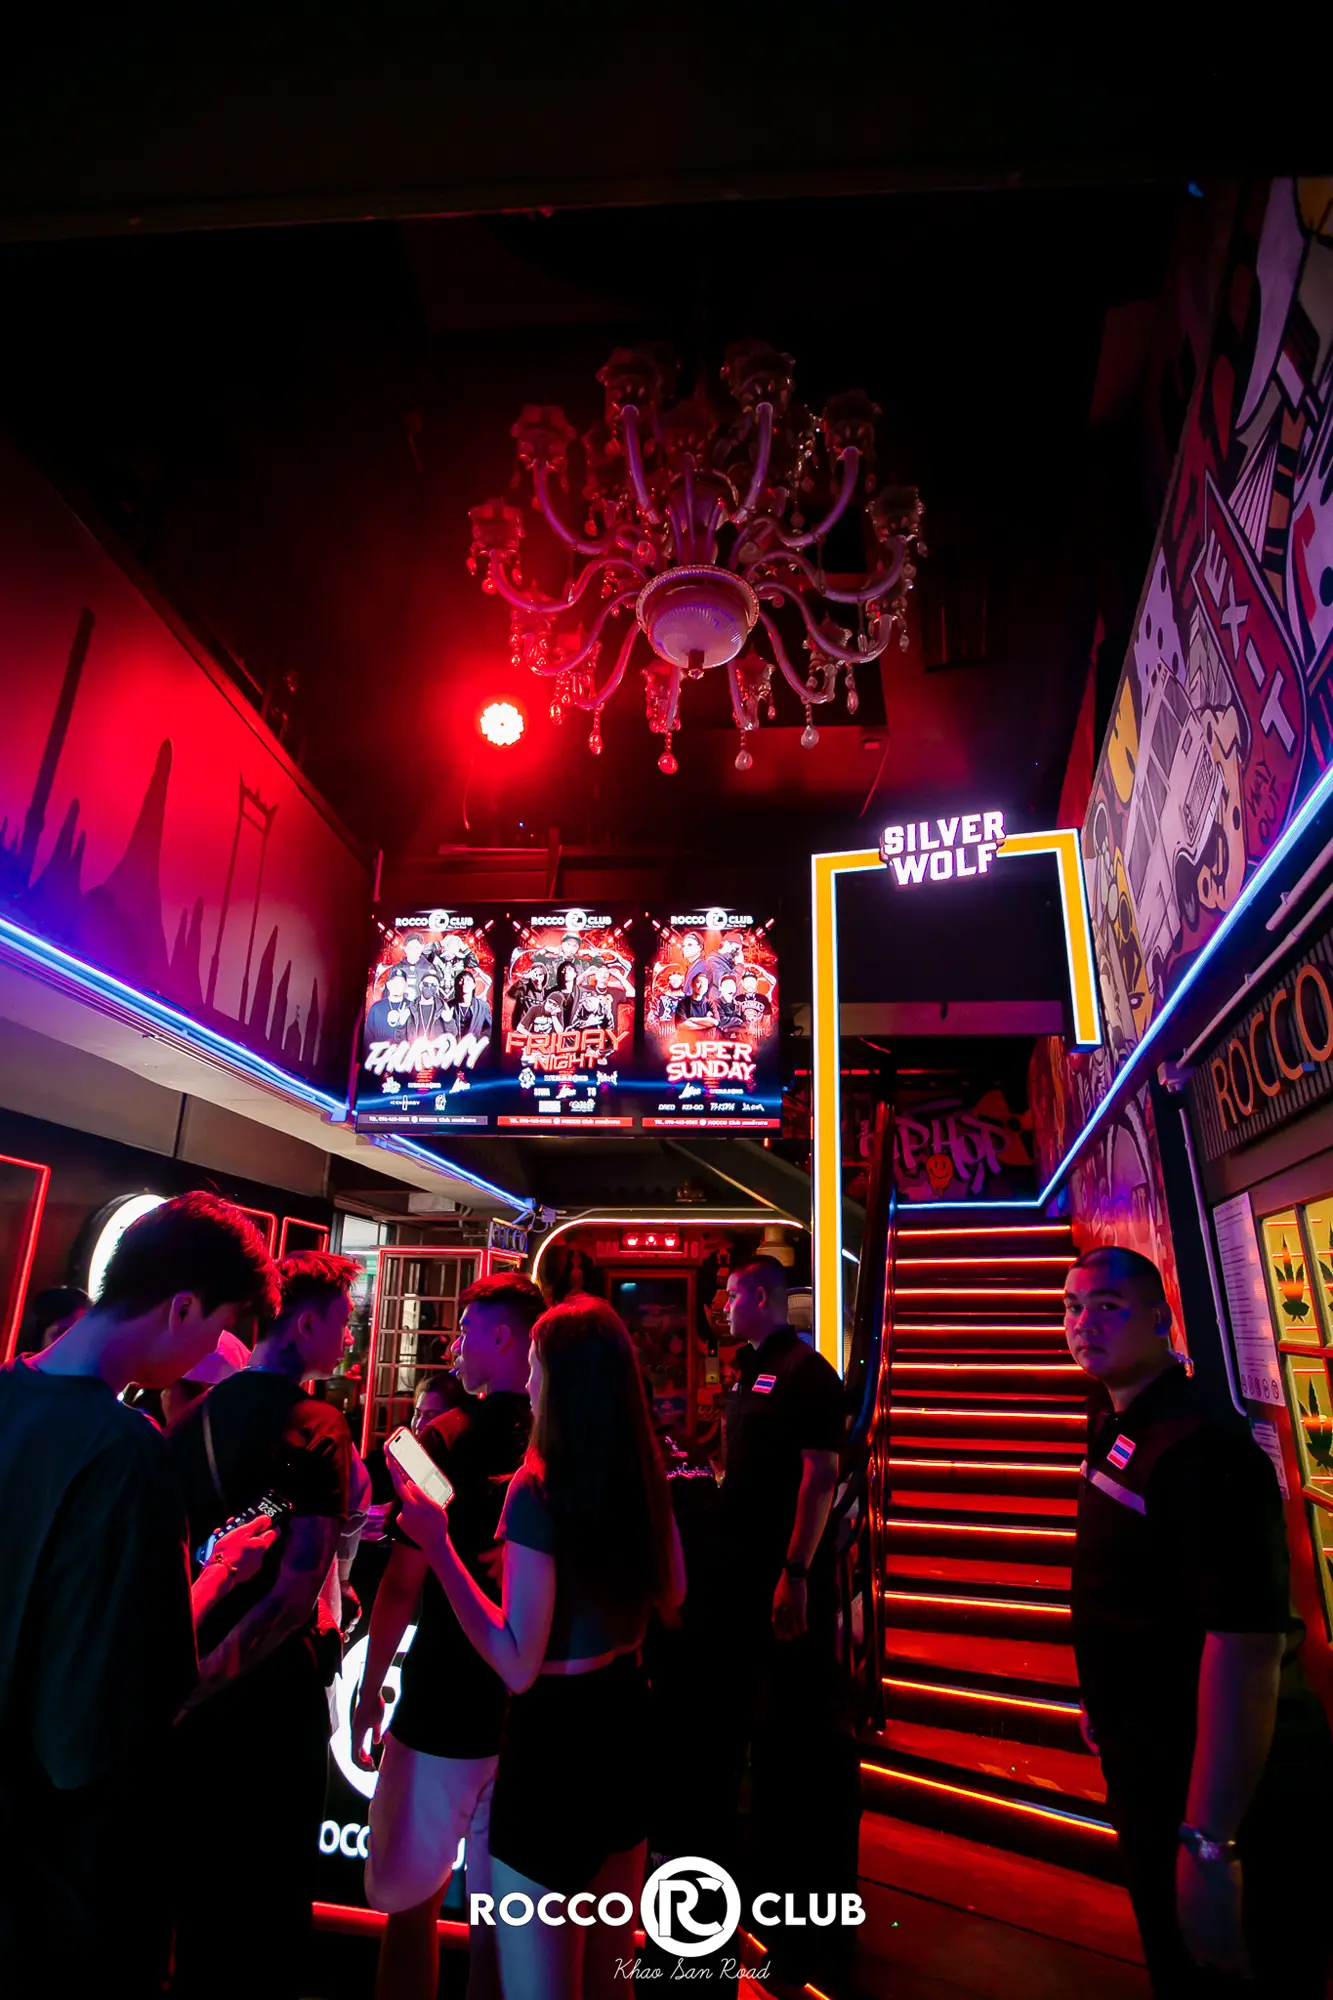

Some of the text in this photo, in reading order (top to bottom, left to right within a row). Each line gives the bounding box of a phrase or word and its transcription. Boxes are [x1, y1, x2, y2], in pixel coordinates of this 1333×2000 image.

[883, 811, 1005, 856] SILVER
[890, 842, 998, 885] WOLF
[395, 917, 475, 927] ROCCO CLUB
[531, 916, 613, 926] ROCCO CLUB
[670, 915, 754, 925] ROCCO CLUB
[505, 1029, 629, 1055] FRIDAY
[668, 1040, 753, 1062] SUPER
[1211, 964, 1333, 1131] ROCCO
[533, 1053, 601, 1071] NIGHT
[665, 1061, 757, 1082] SUNDAY
